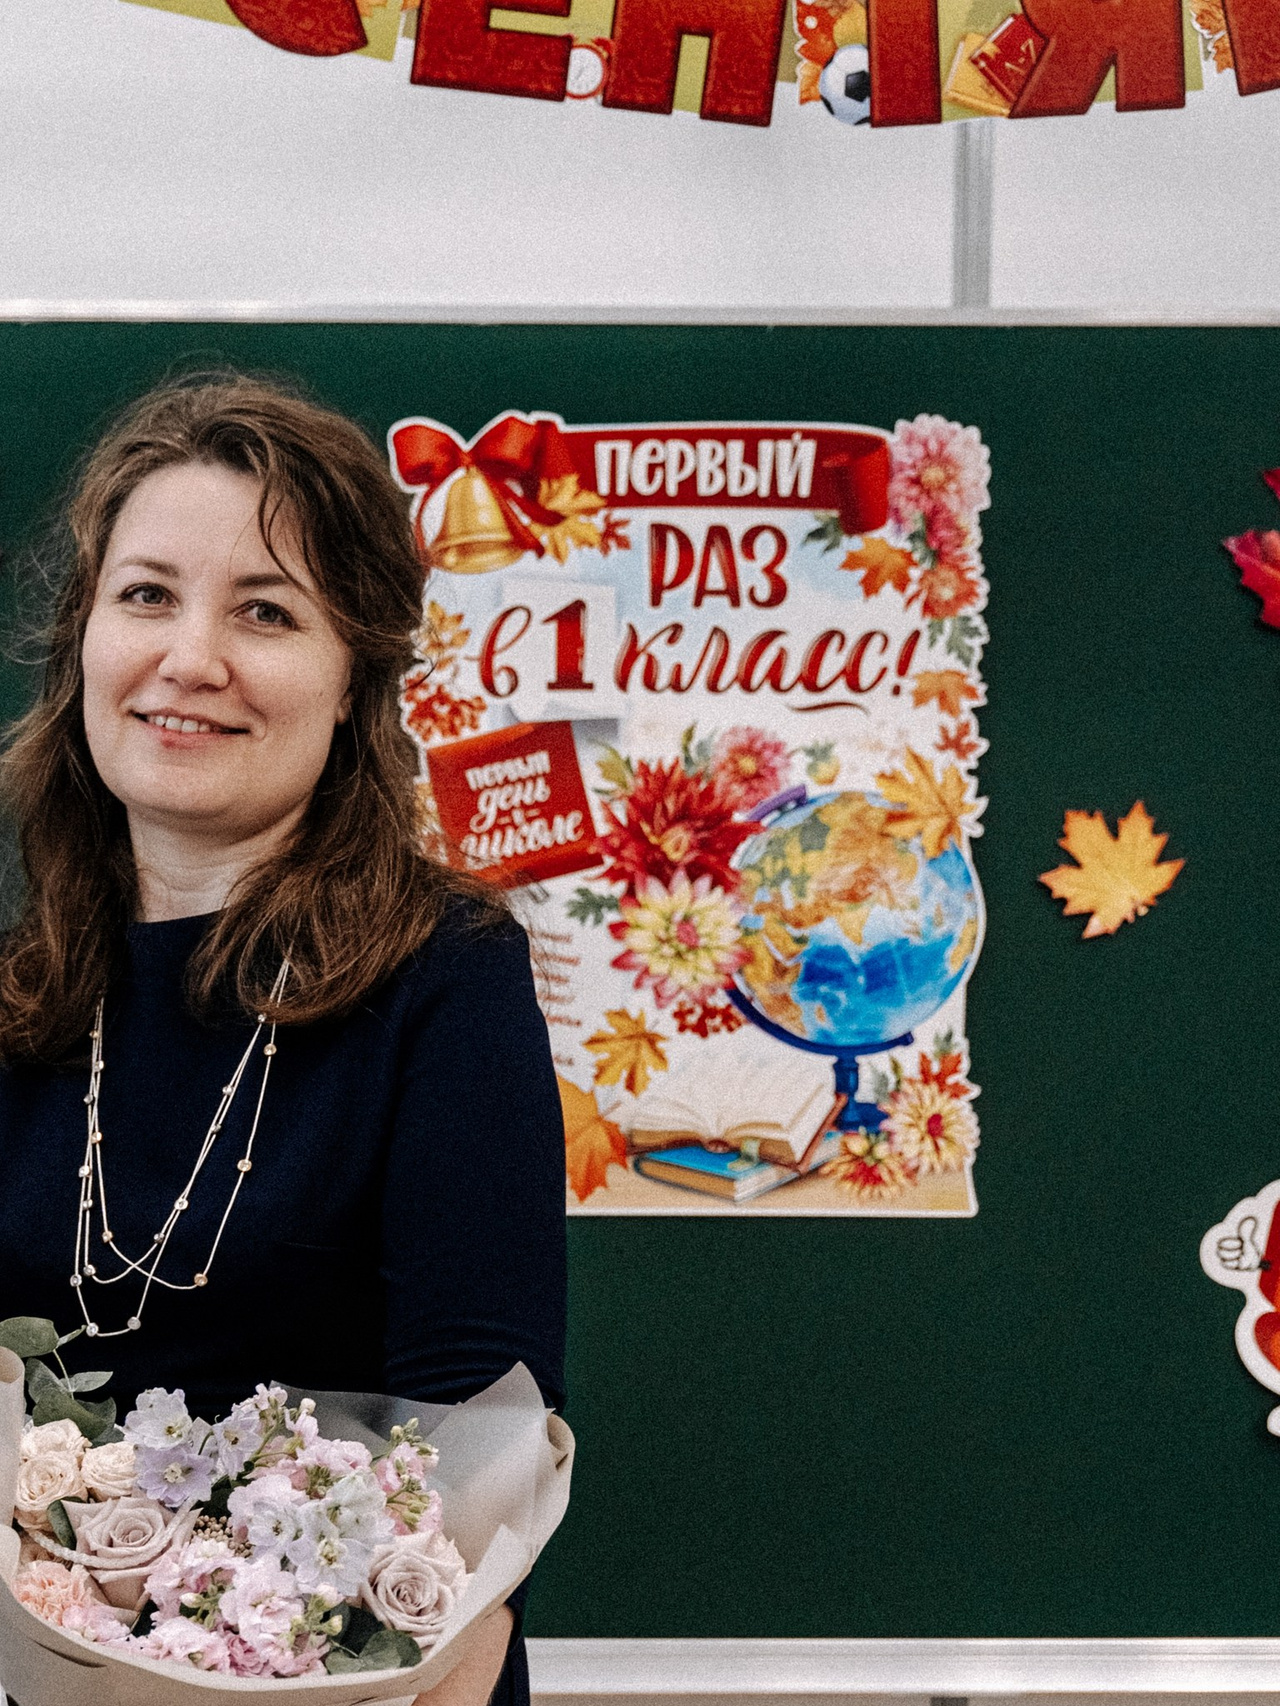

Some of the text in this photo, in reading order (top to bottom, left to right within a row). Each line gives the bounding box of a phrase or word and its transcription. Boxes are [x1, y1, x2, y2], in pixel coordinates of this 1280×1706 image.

[593, 431, 817, 498] ПЕРВЫЙ
[649, 523, 788, 608] РАЗ
[542, 600, 594, 690] 1
[614, 623, 921, 697] класс!
